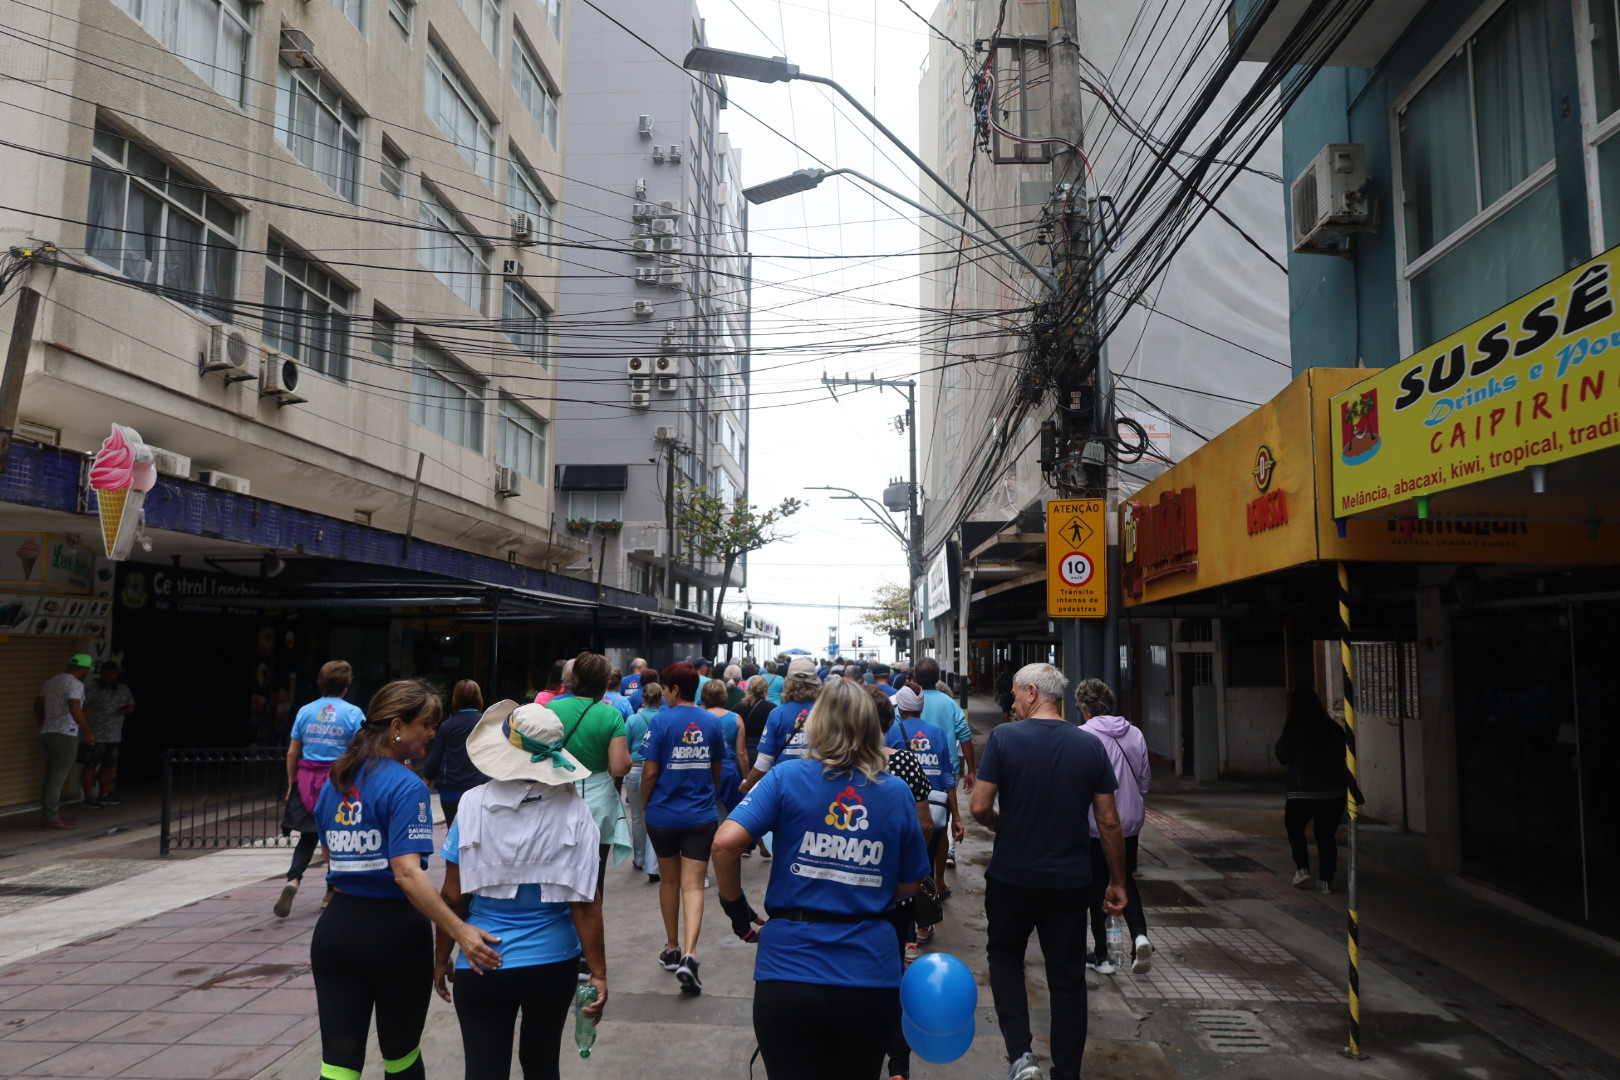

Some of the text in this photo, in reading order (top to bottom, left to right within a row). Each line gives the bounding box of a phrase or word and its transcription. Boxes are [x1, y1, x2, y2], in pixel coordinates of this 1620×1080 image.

[1424, 374, 1518, 427] Drinks
[1528, 363, 1544, 381] e
[1430, 370, 1620, 454] CAIPIRIN
[1342, 411, 1620, 511] Melância, abacaxi, kiwi, tropical, tradi
[1053, 502, 1100, 514] ATENÇÃO
[1067, 561, 1086, 574] 10
[913, 753, 939, 766] RAÇO
[798, 831, 884, 866] ABRAÇO
